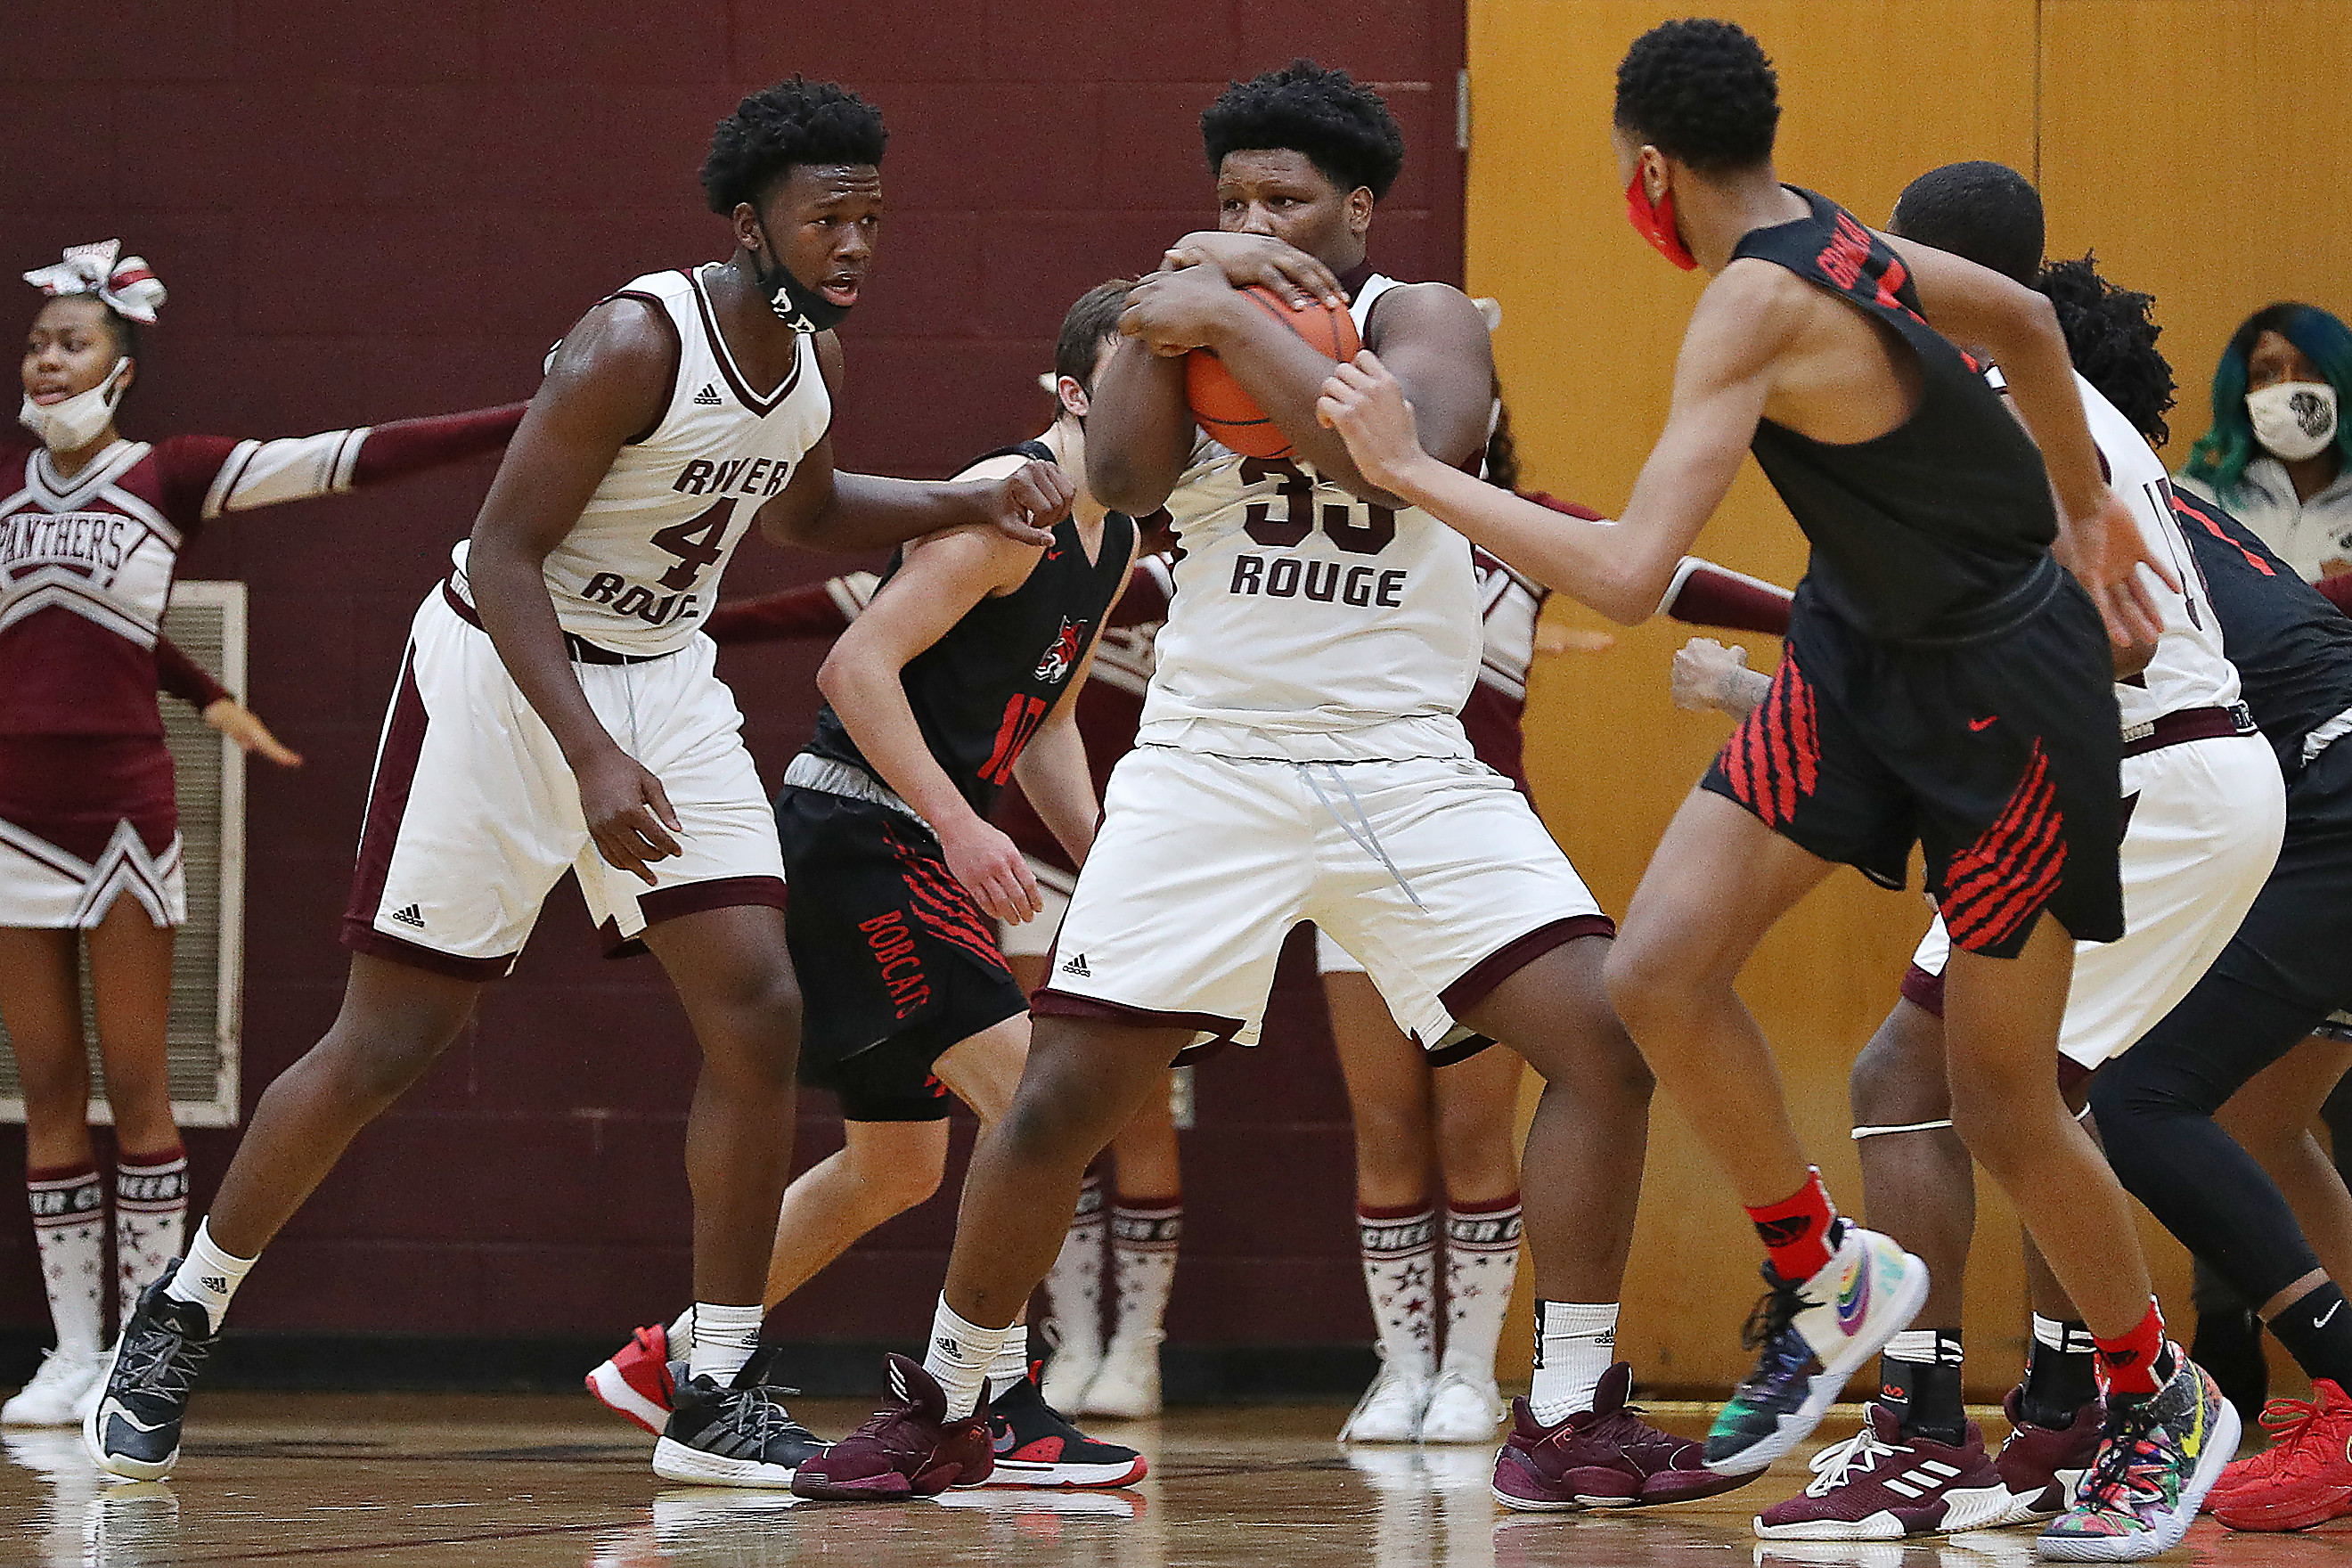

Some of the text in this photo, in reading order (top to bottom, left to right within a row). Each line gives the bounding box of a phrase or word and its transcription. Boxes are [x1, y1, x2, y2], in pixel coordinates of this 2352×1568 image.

[673, 458, 788, 496] RIVER
[649, 495, 739, 592] 4
[1229, 554, 1408, 608] ROUGE
